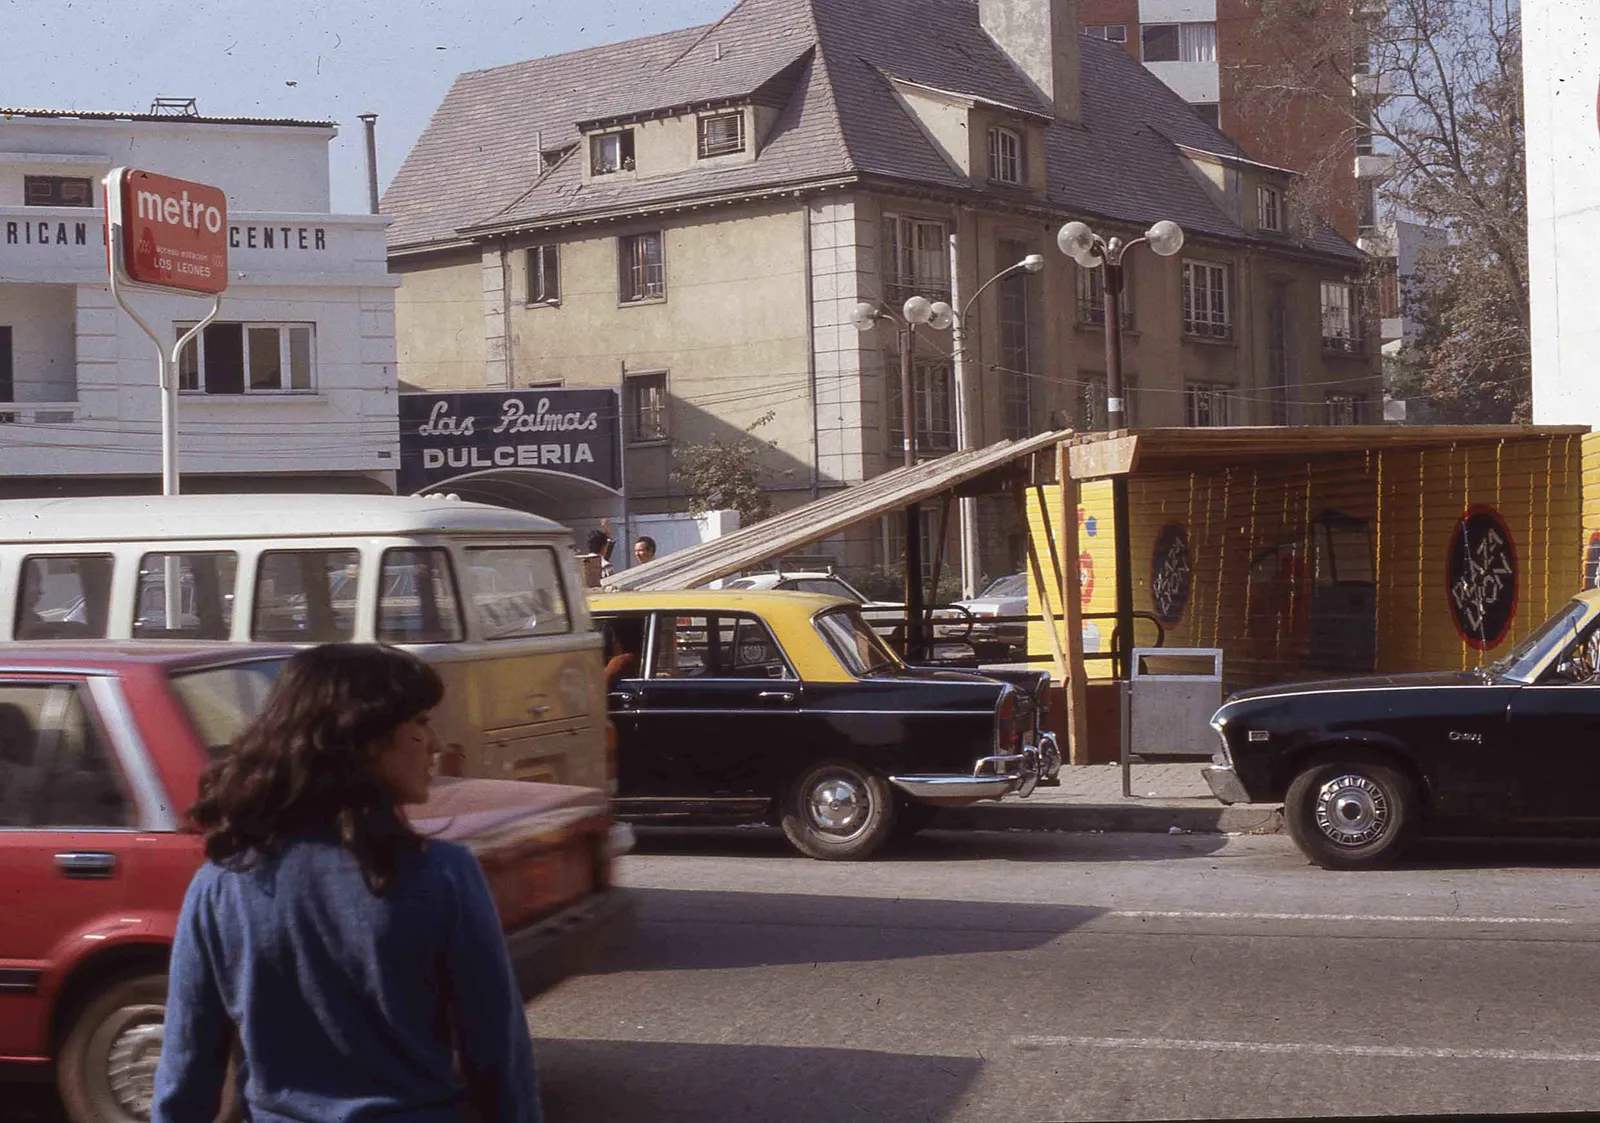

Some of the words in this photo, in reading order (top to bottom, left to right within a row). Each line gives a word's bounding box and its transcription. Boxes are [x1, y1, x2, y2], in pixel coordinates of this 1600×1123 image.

[137, 190, 222, 234] metro
[7, 222, 86, 245] RICAN
[229, 226, 327, 250] CENTER
[154, 257, 172, 271] LOS
[176, 261, 211, 278] LEONES
[418, 400, 476, 436] Las
[492, 398, 598, 434] Palmas
[423, 443, 595, 469] DULCERIA
